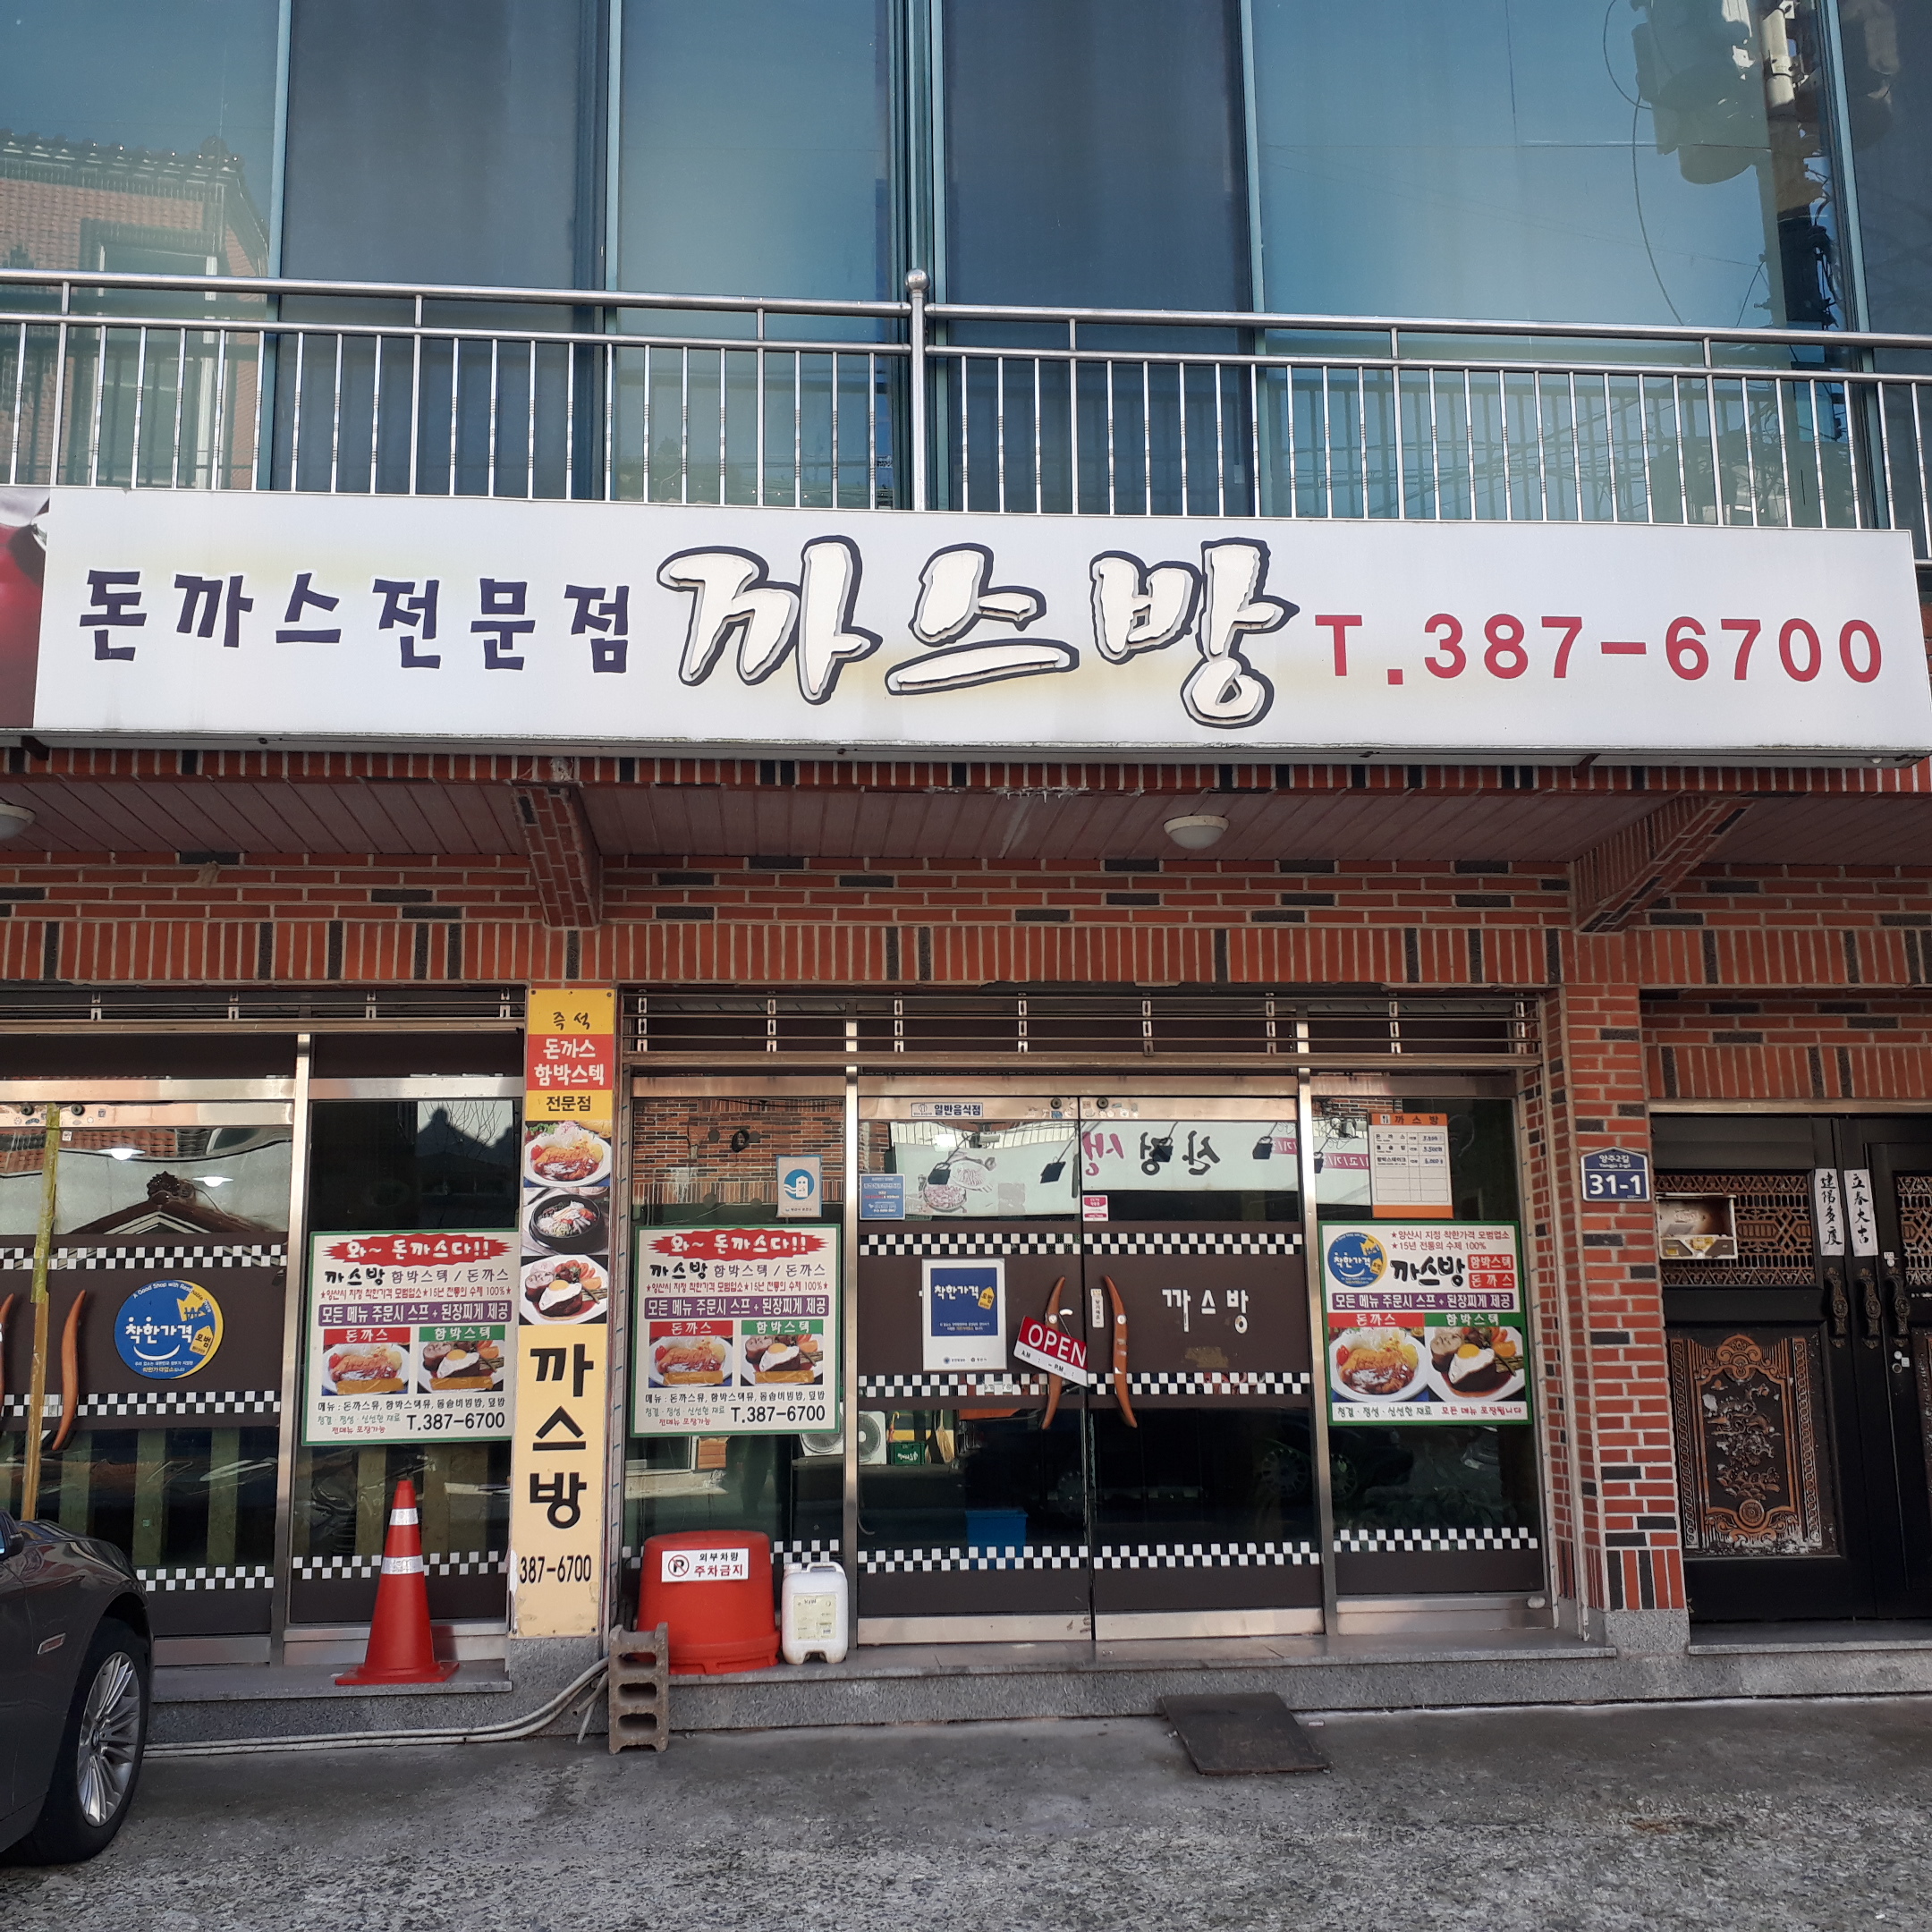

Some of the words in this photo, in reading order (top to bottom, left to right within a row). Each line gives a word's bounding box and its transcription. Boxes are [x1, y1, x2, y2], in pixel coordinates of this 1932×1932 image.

[79, 569, 631, 674] 돈까스전문점
[656, 534, 1300, 729] 까스방
[1314, 613, 1882, 685] T.387-6700
[552, 1011, 591, 1031] 즉석
[542, 1038, 597, 1060] 돈까스
[533, 1063, 606, 1087] 함박스텍
[546, 1095, 591, 1112] 전문점
[934, 1104, 981, 1116] 일반음식점
[1394, 1114, 1439, 1125] 까스방
[1598, 1155, 1630, 1164] 양주2길
[1589, 1174, 1641, 1196] 31-1
[713, 1233, 807, 1255] 돈까스다!!
[1398, 1231, 1422, 1240] 양산시
[1425, 1231, 1441, 1240] 지정
[1444, 1231, 1475, 1240] 착한가격
[1478, 1231, 1511, 1240] 모범업소
[391, 1239, 490, 1260] 돈까스다!!
[1399, 1241, 1417, 1250] 15년
[1420, 1241, 1443, 1250] 전통의
[1445, 1241, 1462, 1250] 수제
[1466, 1241, 1487, 1250] 100%
[649, 1261, 708, 1280] 까스방
[713, 1264, 767, 1278] 함박스텍
[785, 1263, 826, 1277] 돈까스
[1390, 1255, 1466, 1287] 까스방
[1470, 1256, 1513, 1268] 함박스텍
[324, 1267, 386, 1286] 까스방
[391, 1269, 450, 1284] 함박스텍
[466, 1267, 510, 1284] 돈까스
[804, 1281, 822, 1291] 100%
[1470, 1275, 1513, 1287] 돈까스
[137, 1285, 153, 1295] Good
[486, 1286, 505, 1296] 100%
[934, 1284, 979, 1301] 착한가격
[648, 1299, 668, 1317] 모든
[672, 1299, 692, 1317] 메뉴
[696, 1298, 726, 1316] 주문시
[730, 1298, 750, 1315] 스프
[806, 1296, 826, 1315] 제공
[1335, 1294, 1356, 1308] 모든
[1359, 1294, 1378, 1308] 메뉴
[1382, 1294, 1412, 1308] 주문시
[1416, 1294, 1436, 1307] 스프
[1490, 1294, 1511, 1308] 제공
[322, 1305, 343, 1324] 모든
[347, 1305, 369, 1324] 메뉴
[371, 1304, 404, 1324] 주문시
[407, 1304, 429, 1321] 스프
[487, 1302, 509, 1320] 제공
[1162, 1289, 1250, 1334] 까스방
[1356, 1313, 1396, 1326] 돈까스
[125, 1316, 193, 1344] 착한가격
[345, 1328, 388, 1343] 돈까스
[671, 1322, 712, 1335] 돈까스
[195, 1333, 212, 1349] 모범
[1028, 1324, 1087, 1368] OPEN
[406, 1411, 505, 1431] T.387-6700
[730, 1404, 826, 1423] T.387-6700
[1387, 1406, 1413, 1417] 신선한
[1441, 1406, 1457, 1415] 모든
[530, 1343, 595, 1530] 까스방
[699, 1551, 739, 1563] 외부차량
[519, 1554, 592, 1584] 387-6700
[694, 1563, 743, 1578] 주차금지
